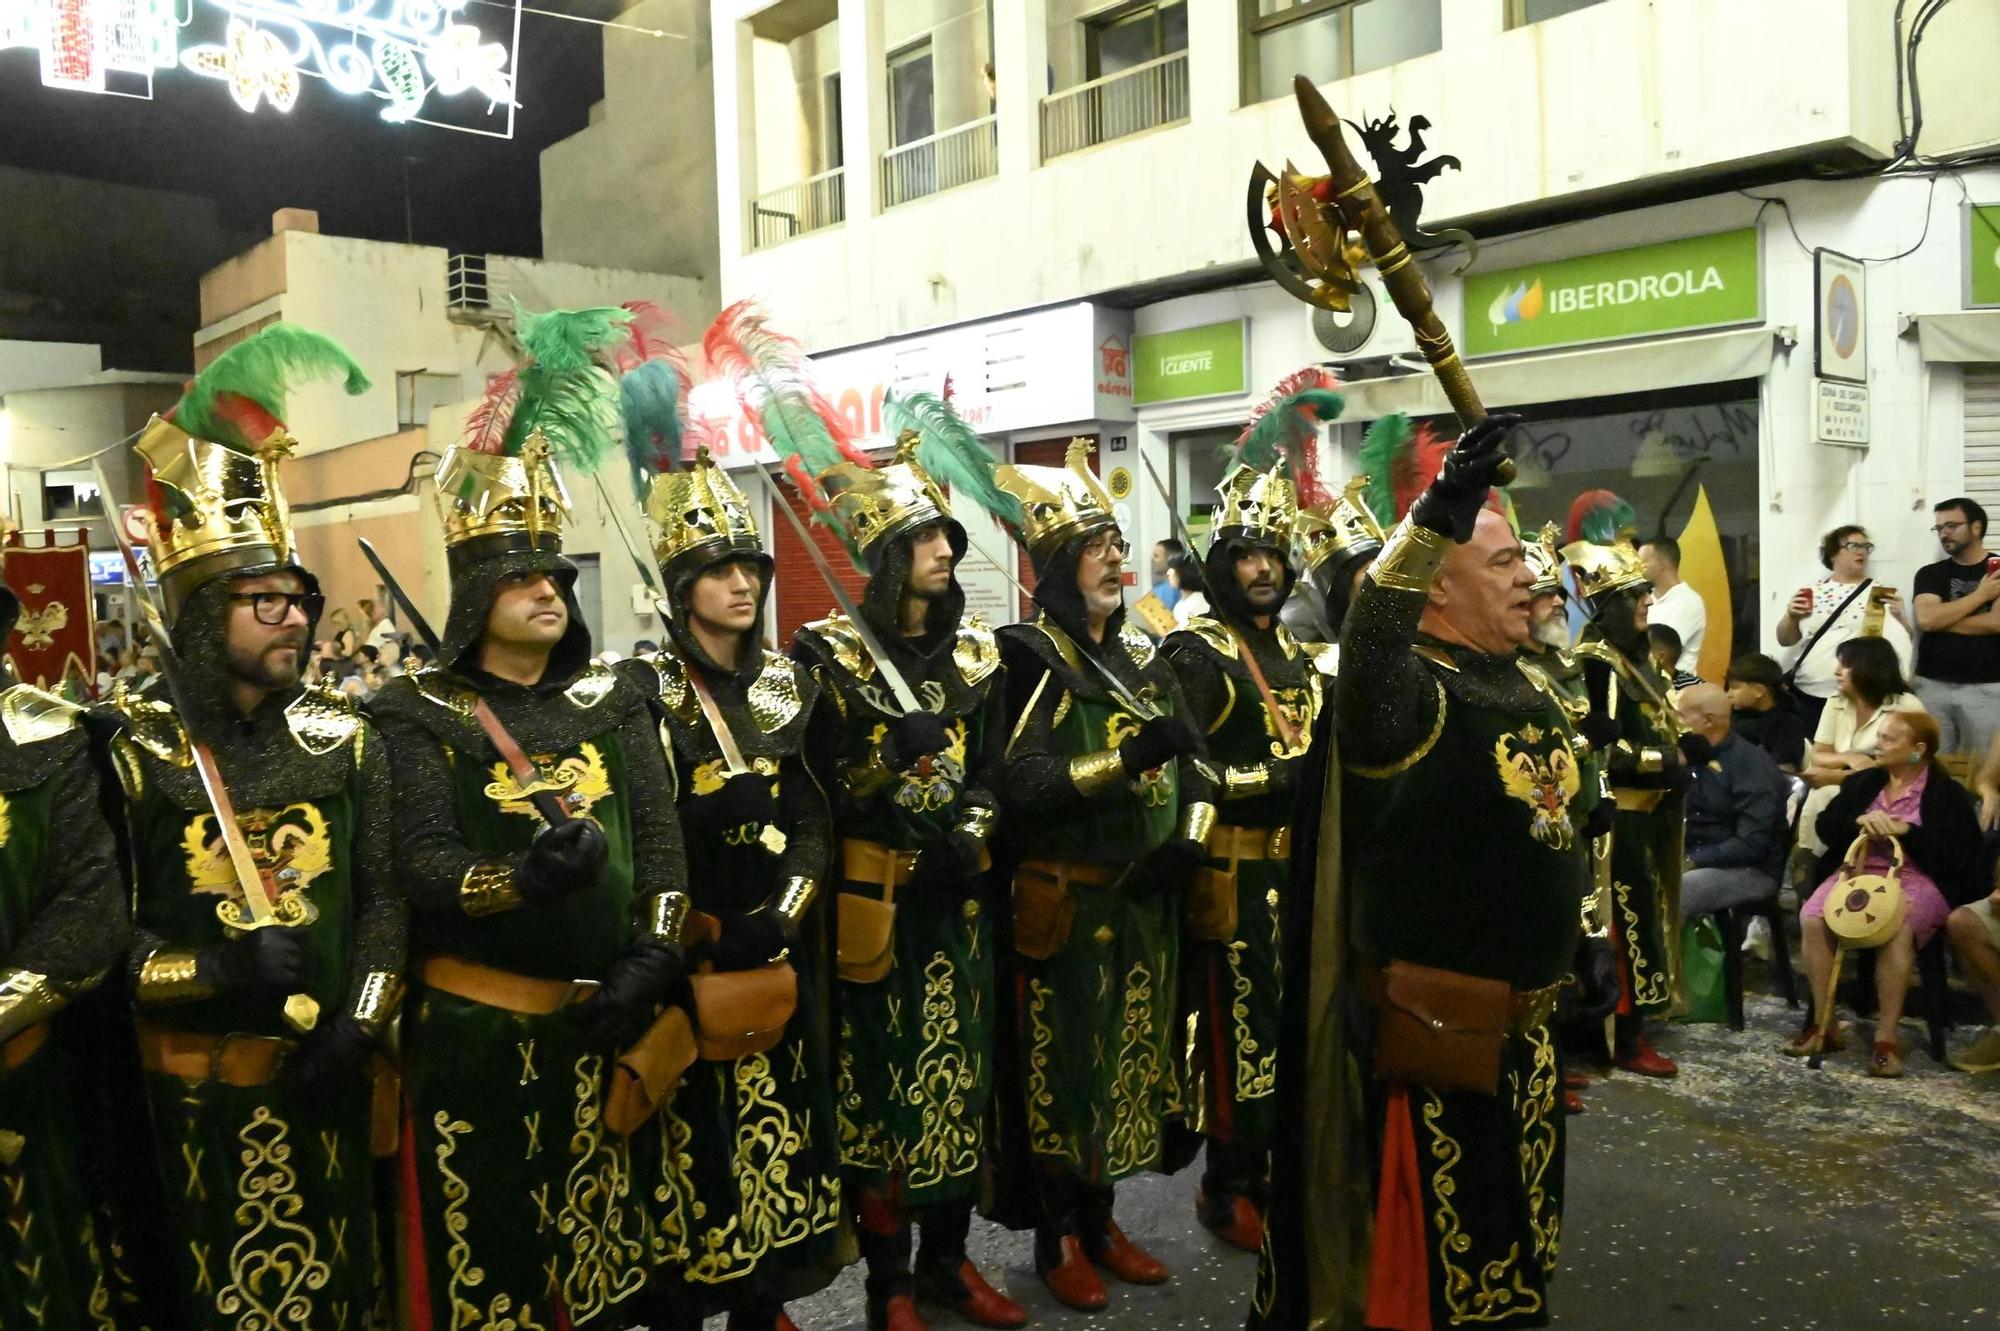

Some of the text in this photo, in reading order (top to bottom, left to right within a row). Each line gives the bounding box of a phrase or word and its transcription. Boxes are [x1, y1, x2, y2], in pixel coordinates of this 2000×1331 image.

[1549, 266, 1725, 314] IBERDROLA
[1165, 357, 1213, 375] CLIENTE
[961, 405, 992, 425] 1987
